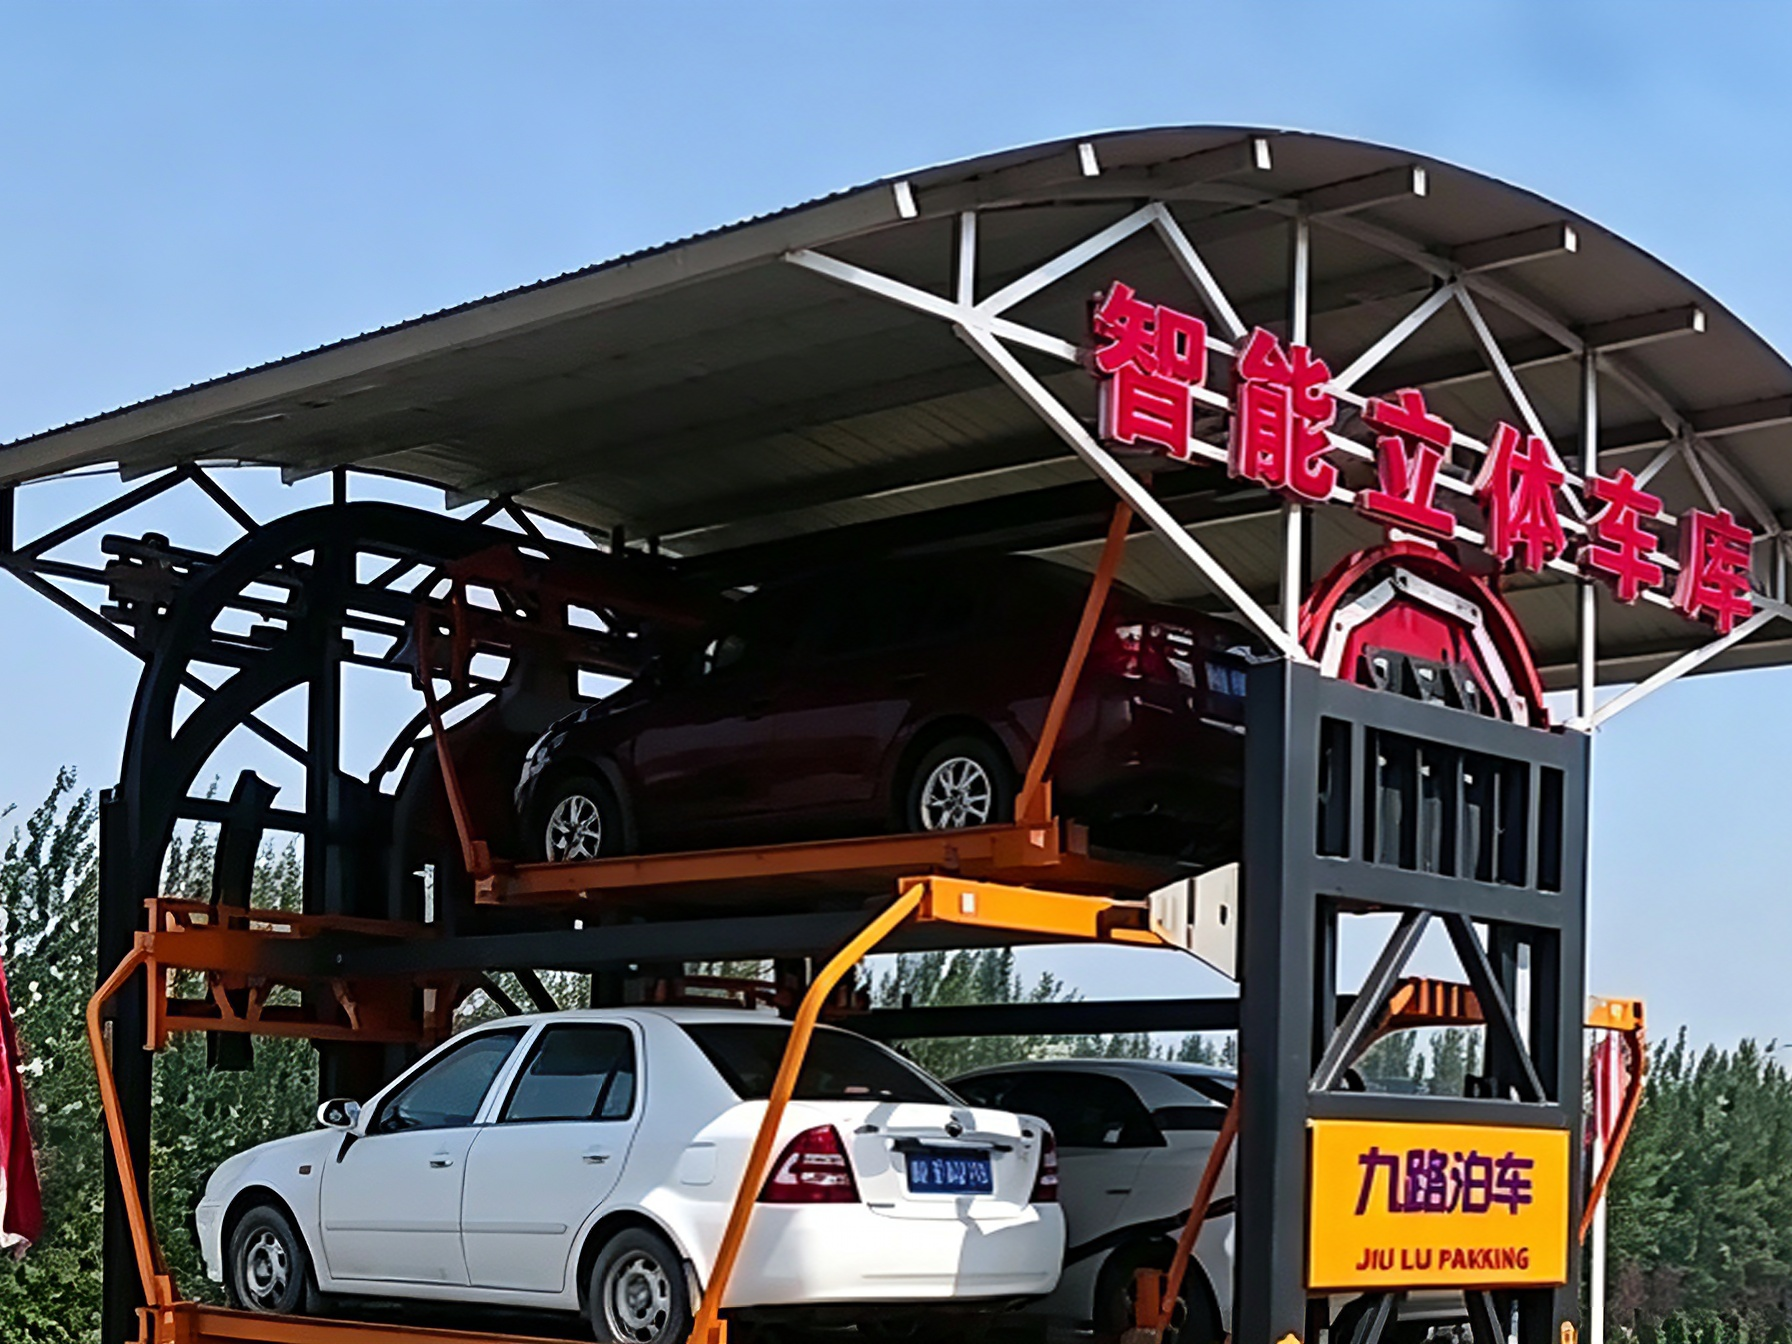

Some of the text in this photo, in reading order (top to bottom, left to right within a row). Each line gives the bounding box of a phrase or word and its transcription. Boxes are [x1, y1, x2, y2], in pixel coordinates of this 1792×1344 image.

[1093, 281, 1755, 635] 智能立体车库
[1354, 1146, 1535, 1216] 九路泊车
[1355, 1247, 1395, 1271] JIU
[1400, 1247, 1432, 1271] LU
